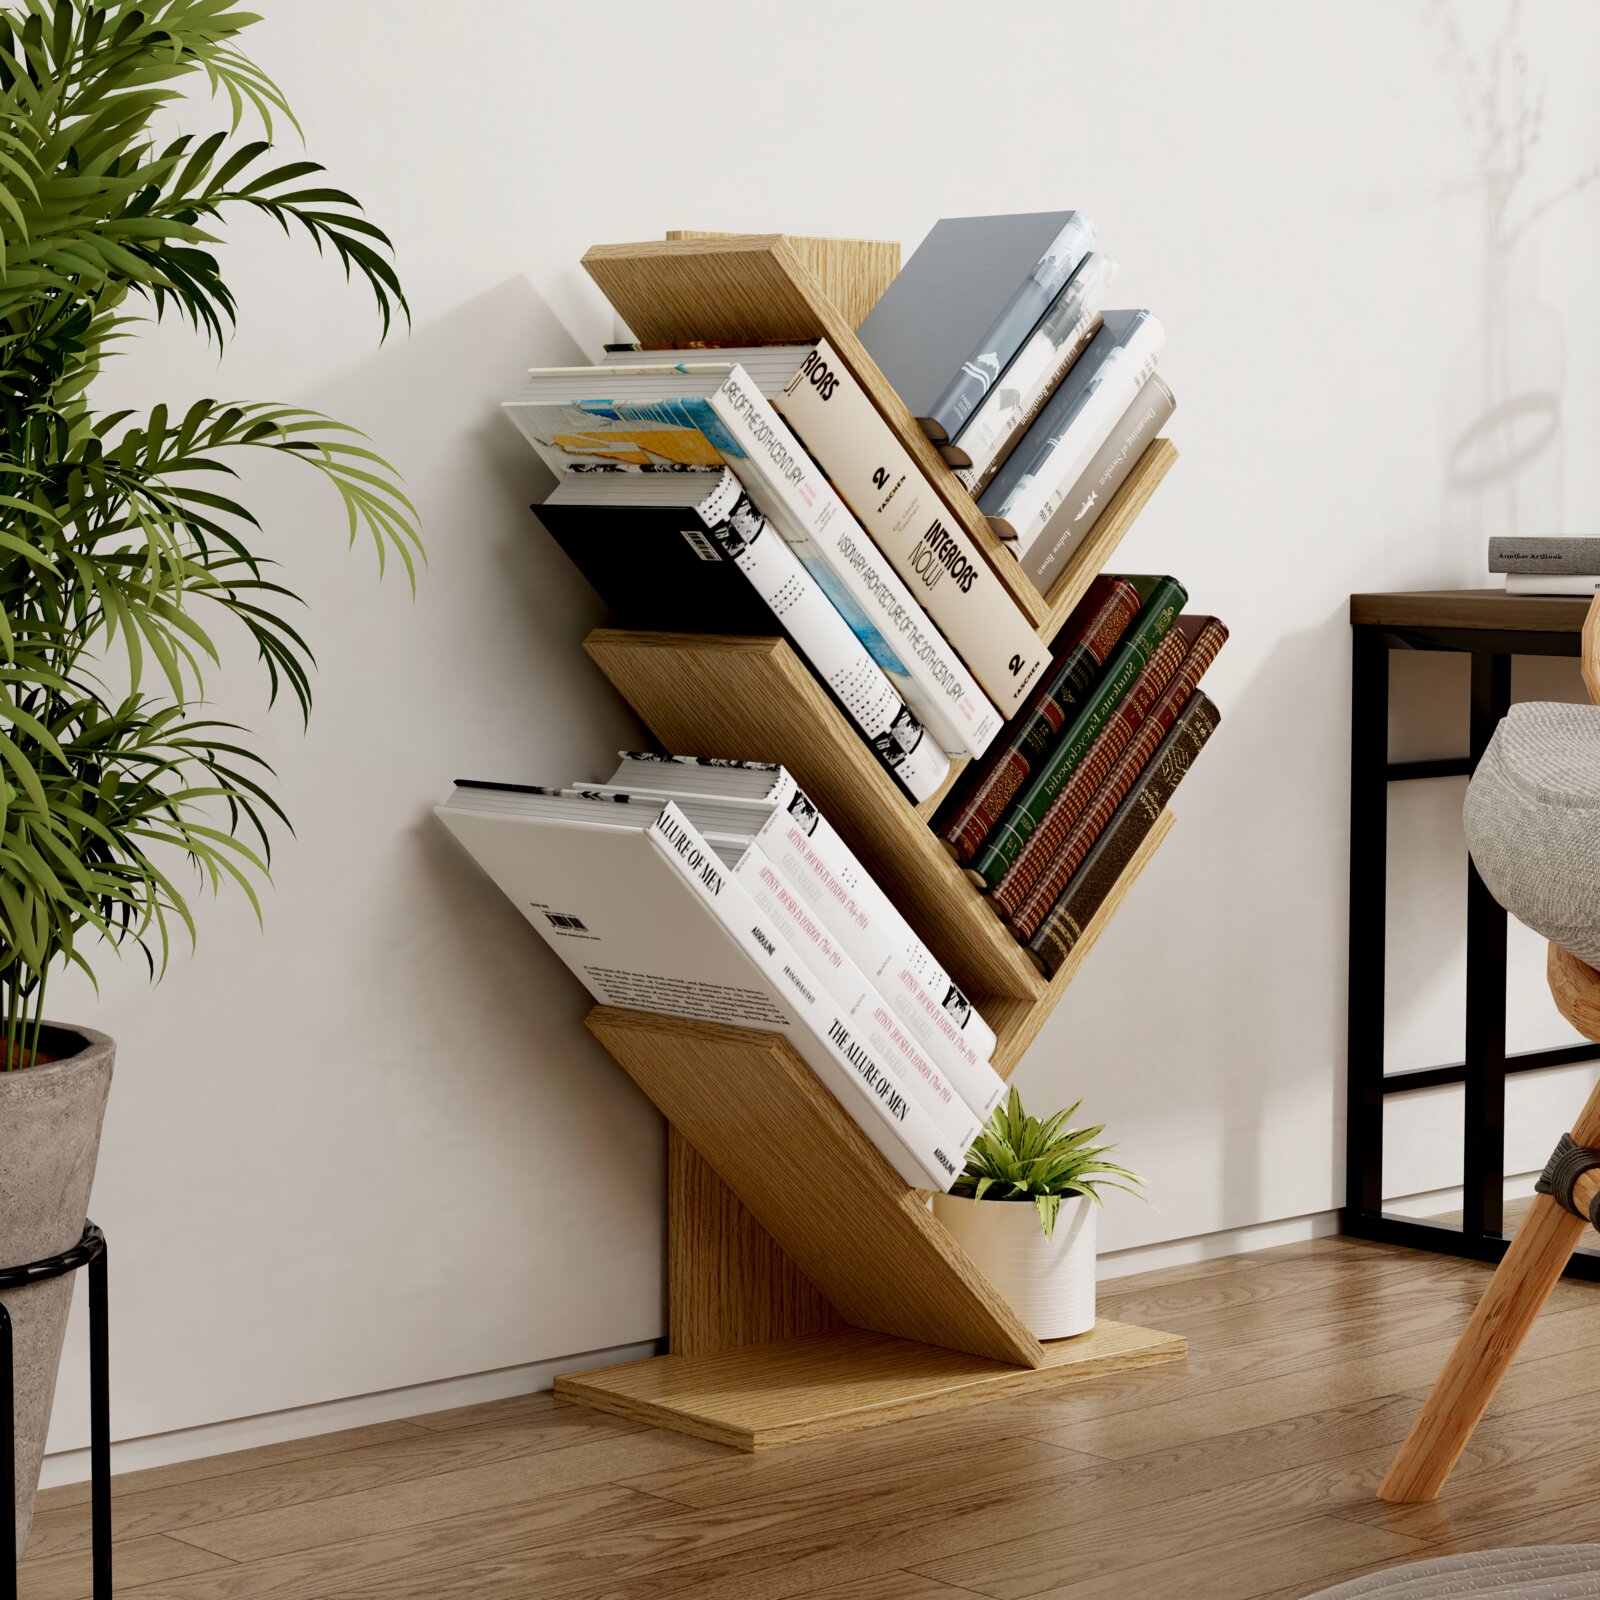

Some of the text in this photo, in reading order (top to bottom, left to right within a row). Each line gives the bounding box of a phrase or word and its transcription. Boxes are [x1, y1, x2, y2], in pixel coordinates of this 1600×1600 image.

[1020, 384, 1049, 426] Revolution
[733, 393, 750, 412] OF
[742, 403, 761, 431] THE
[752, 420, 777, 452] 20TH
[769, 441, 805, 487] CENTURY
[1124, 406, 1157, 447] Dreaming
[1098, 453, 1125, 487] Sweden
[1120, 443, 1132, 460] of
[871, 466, 890, 490] 2
[876, 474, 906, 513] TASCHEN
[907, 540, 944, 591] NOW!
[923, 519, 978, 593] INTERIORS
[1036, 527, 1072, 575] Andrew Brown
[1498, 553, 1563, 561] Another ArtBook
[836, 532, 965, 702] VISIONARY ARCHITECTURE OF THE 20TH CENTURY
[1008, 653, 1026, 677] 2
[1013, 661, 1041, 699] TASCHEN
[686, 848, 706, 871] OF
[698, 862, 725, 896] MEN
[750, 926, 776, 956] ASSOULINE
[827, 1017, 849, 1050] THE
[843, 1041, 880, 1087] ALLURE
[874, 1077, 892, 1098] OF
[885, 1089, 910, 1121] MEN
[932, 1147, 956, 1176] ASSOULINE
